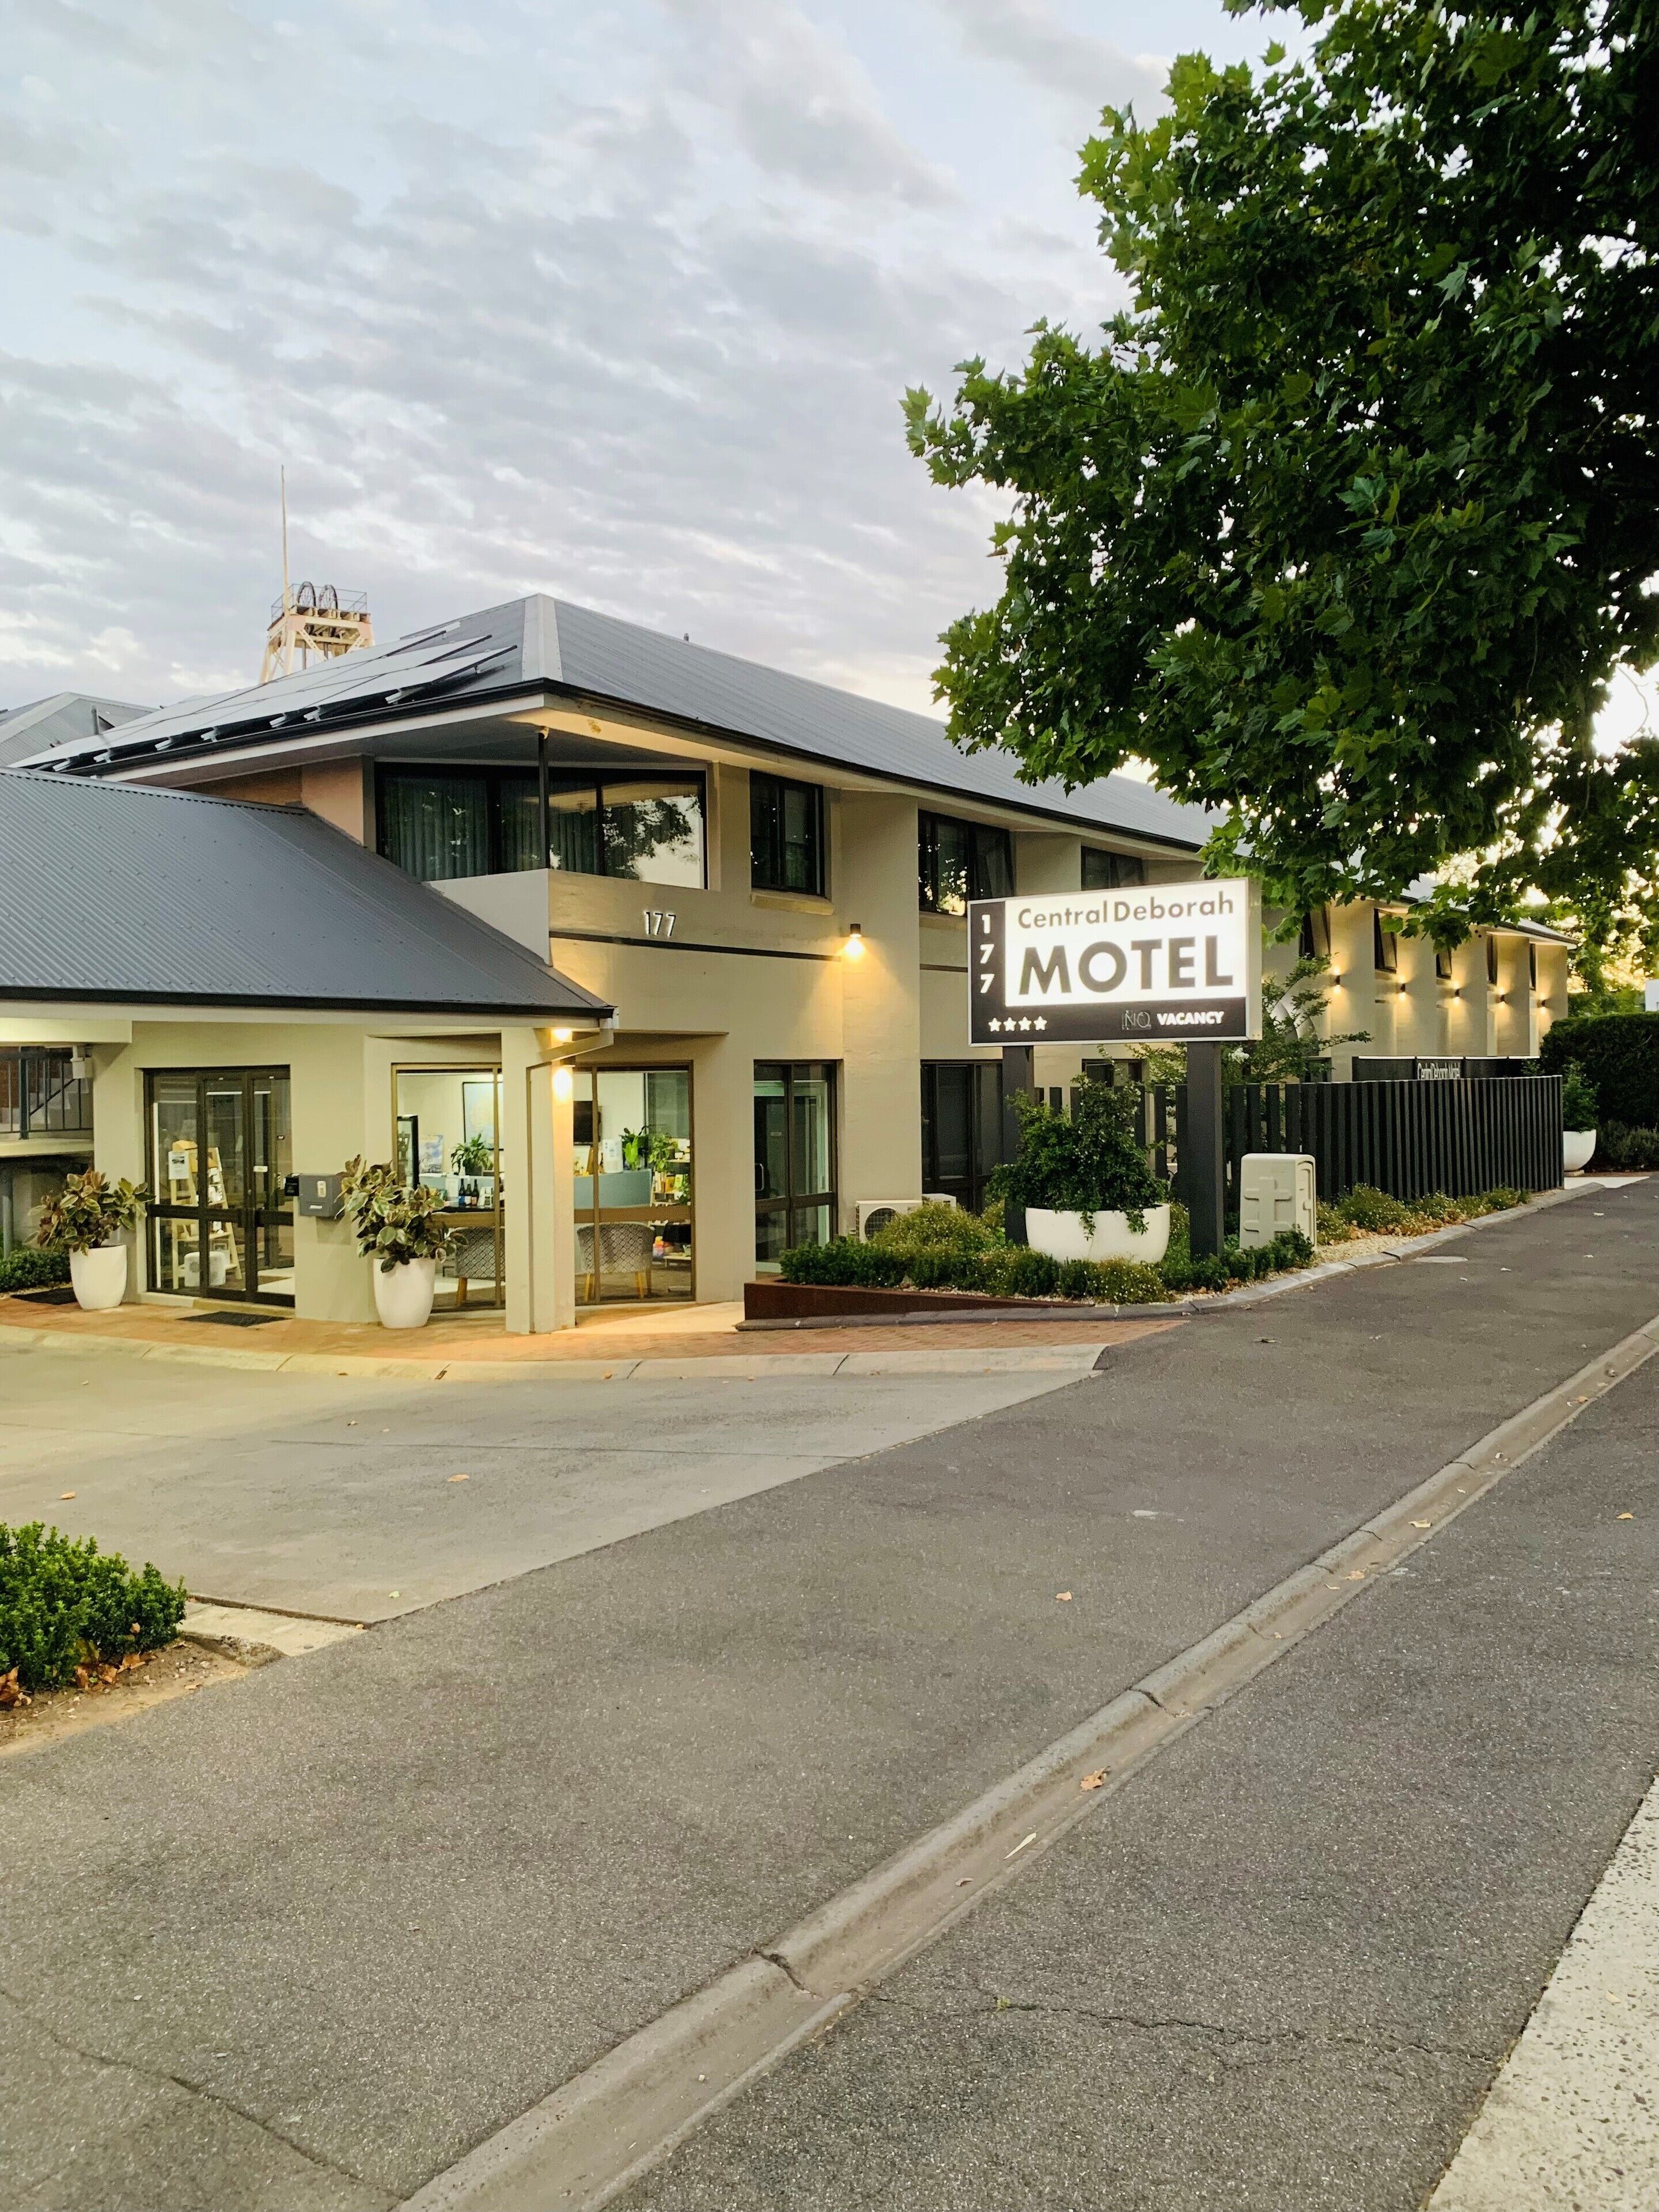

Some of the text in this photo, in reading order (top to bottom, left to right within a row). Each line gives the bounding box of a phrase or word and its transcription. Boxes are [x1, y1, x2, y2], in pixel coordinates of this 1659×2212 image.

[643, 911, 676, 937] 177
[1018, 891, 1233, 929] Central Deborah
[1019, 934, 1233, 995] MOTEL
[1123, 1010, 1225, 1029] NO VACANCY
